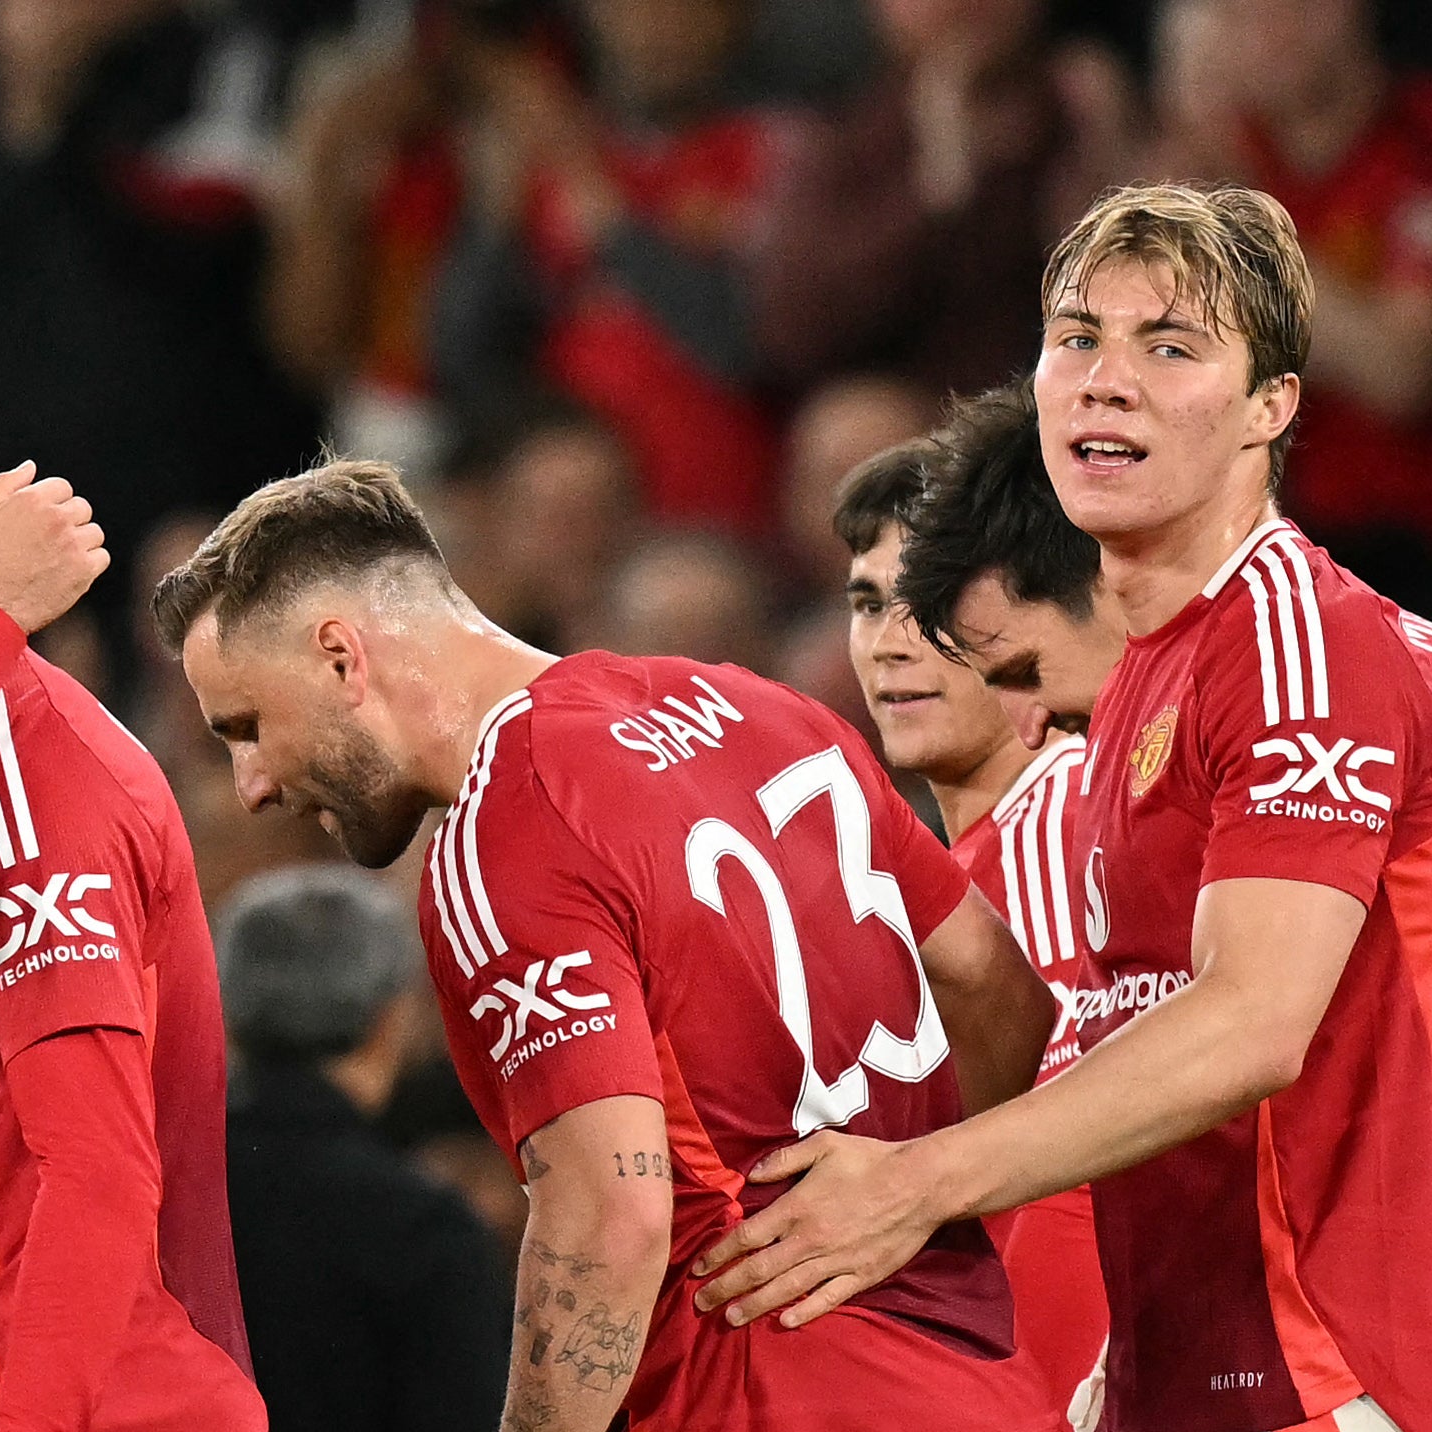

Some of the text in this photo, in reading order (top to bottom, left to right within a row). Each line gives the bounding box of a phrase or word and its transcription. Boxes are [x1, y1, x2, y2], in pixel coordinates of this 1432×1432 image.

[609, 675, 744, 772] SHAW
[1249, 733, 1396, 812] DXC
[1245, 799, 1386, 834] ECHNOLOGY
[685, 745, 952, 1137] 23
[469, 949, 612, 1063] DXC
[500, 1013, 617, 1083] TECHNOLOGY
[1210, 1371, 1265, 1391] HEAT.RDY
